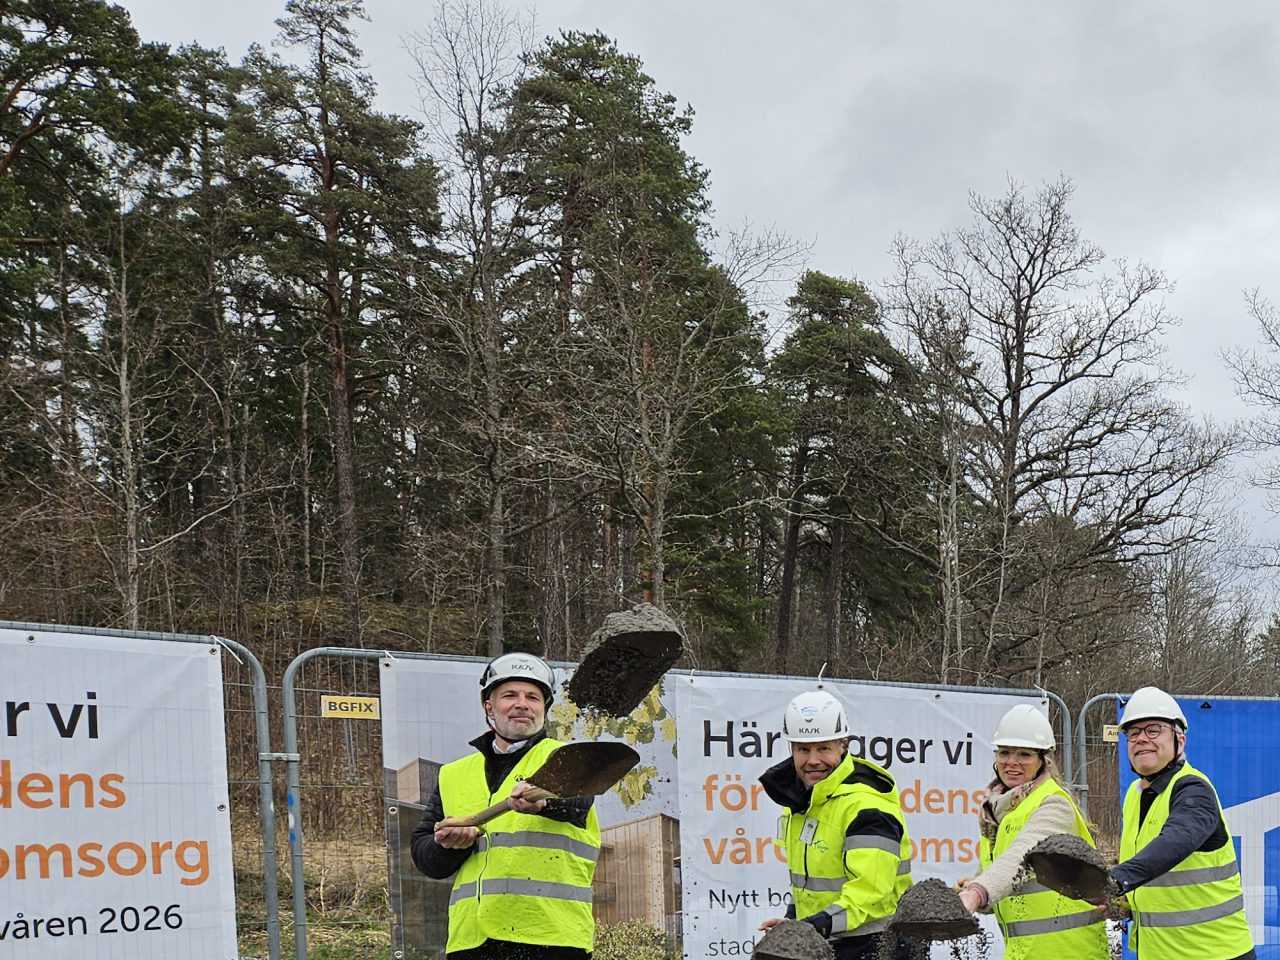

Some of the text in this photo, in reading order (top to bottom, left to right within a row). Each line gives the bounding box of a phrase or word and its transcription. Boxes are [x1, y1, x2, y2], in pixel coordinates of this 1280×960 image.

[46, 691, 99, 739] vi
[328, 701, 374, 713] BGFIX
[703, 719, 973, 770] Här gger vi
[702, 773, 765, 812] för
[0, 840, 210, 886] msorg
[98, 904, 183, 934] 2026
[709, 888, 760, 914] Nytt
